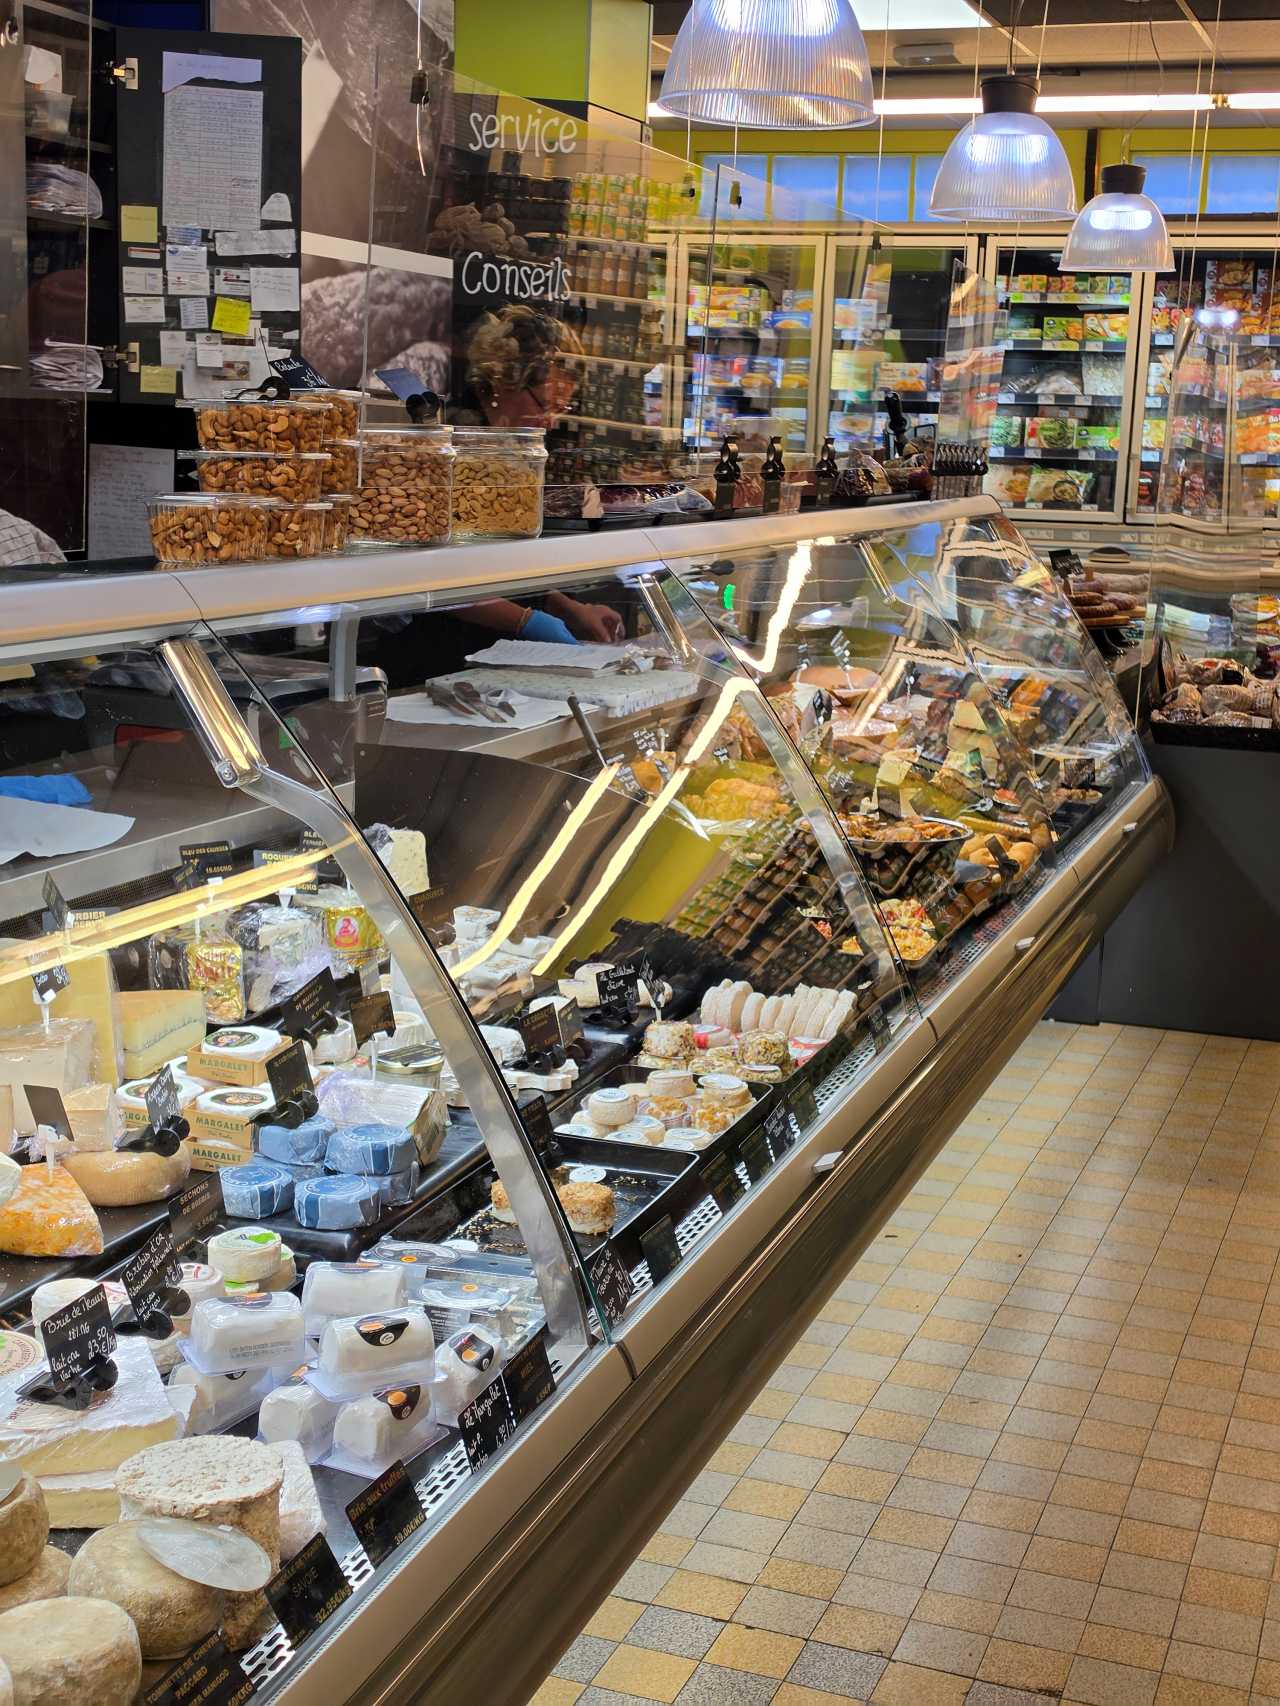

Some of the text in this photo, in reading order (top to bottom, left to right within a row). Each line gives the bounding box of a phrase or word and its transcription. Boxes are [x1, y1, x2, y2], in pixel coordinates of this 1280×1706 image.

[469, 108, 577, 157] service
[462, 251, 572, 301] Conseils
[200, 1057, 249, 1072] MARGALET
[195, 1116, 244, 1132] MARGALET
[192, 1148, 241, 1162] MARGALET
[44, 1315, 72, 1334] Brie
[71, 1303, 83, 1323] de
